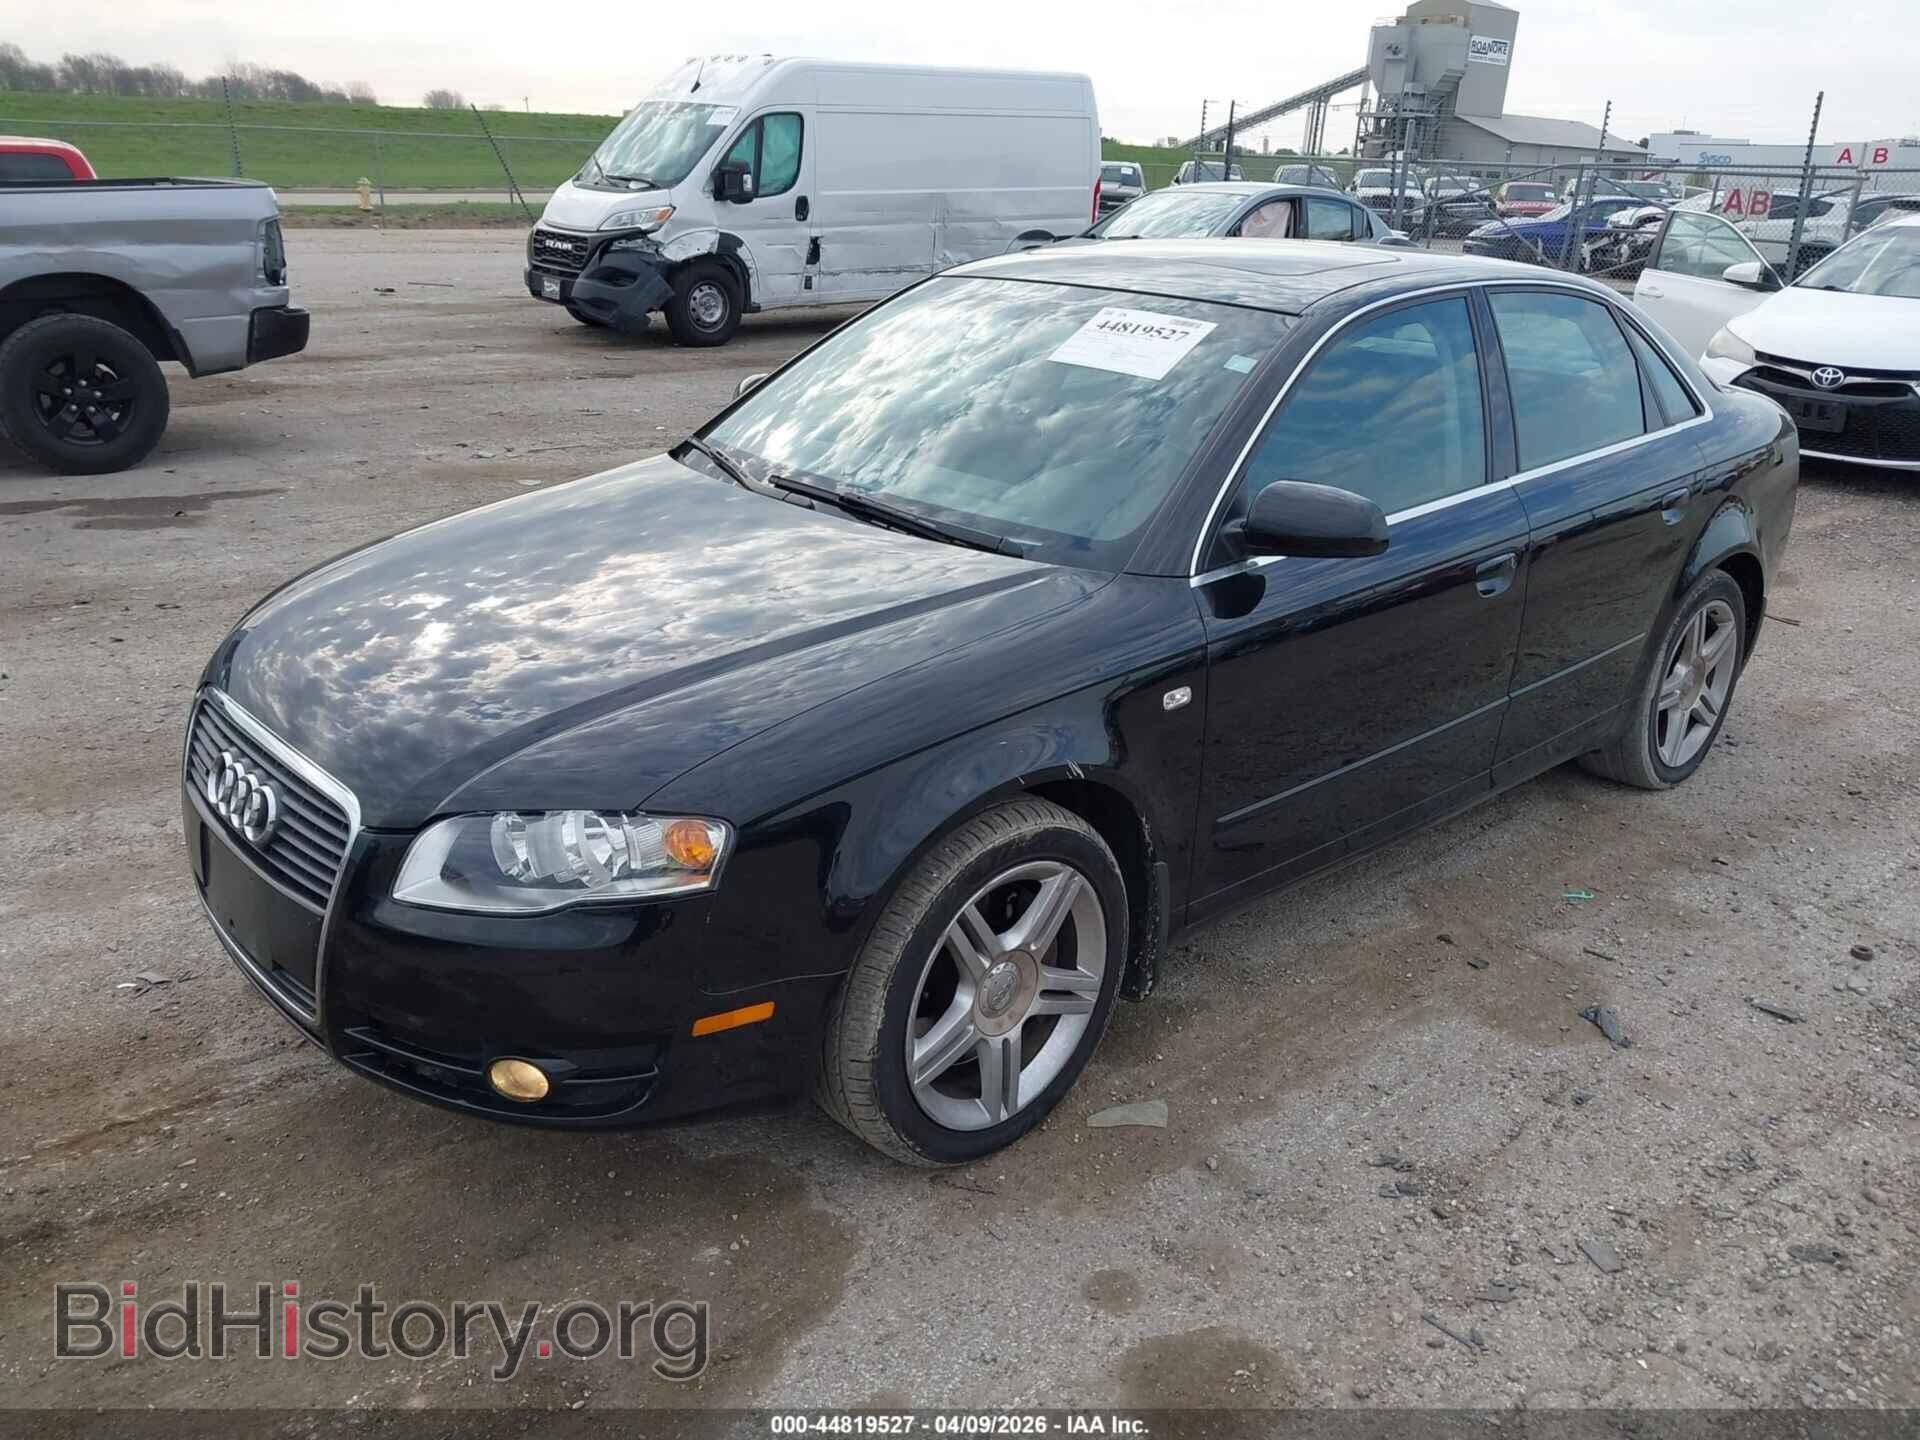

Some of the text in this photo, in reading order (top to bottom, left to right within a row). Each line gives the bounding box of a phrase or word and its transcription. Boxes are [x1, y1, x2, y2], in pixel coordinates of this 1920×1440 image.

[1471, 39, 1508, 56] ROANOKE
[1699, 151, 1732, 165] Sysco
[1836, 147, 1889, 164] A B
[1723, 188, 1771, 215] A B
[545, 239, 573, 250] RAM
[1097, 320, 1190, 342] 44819527
